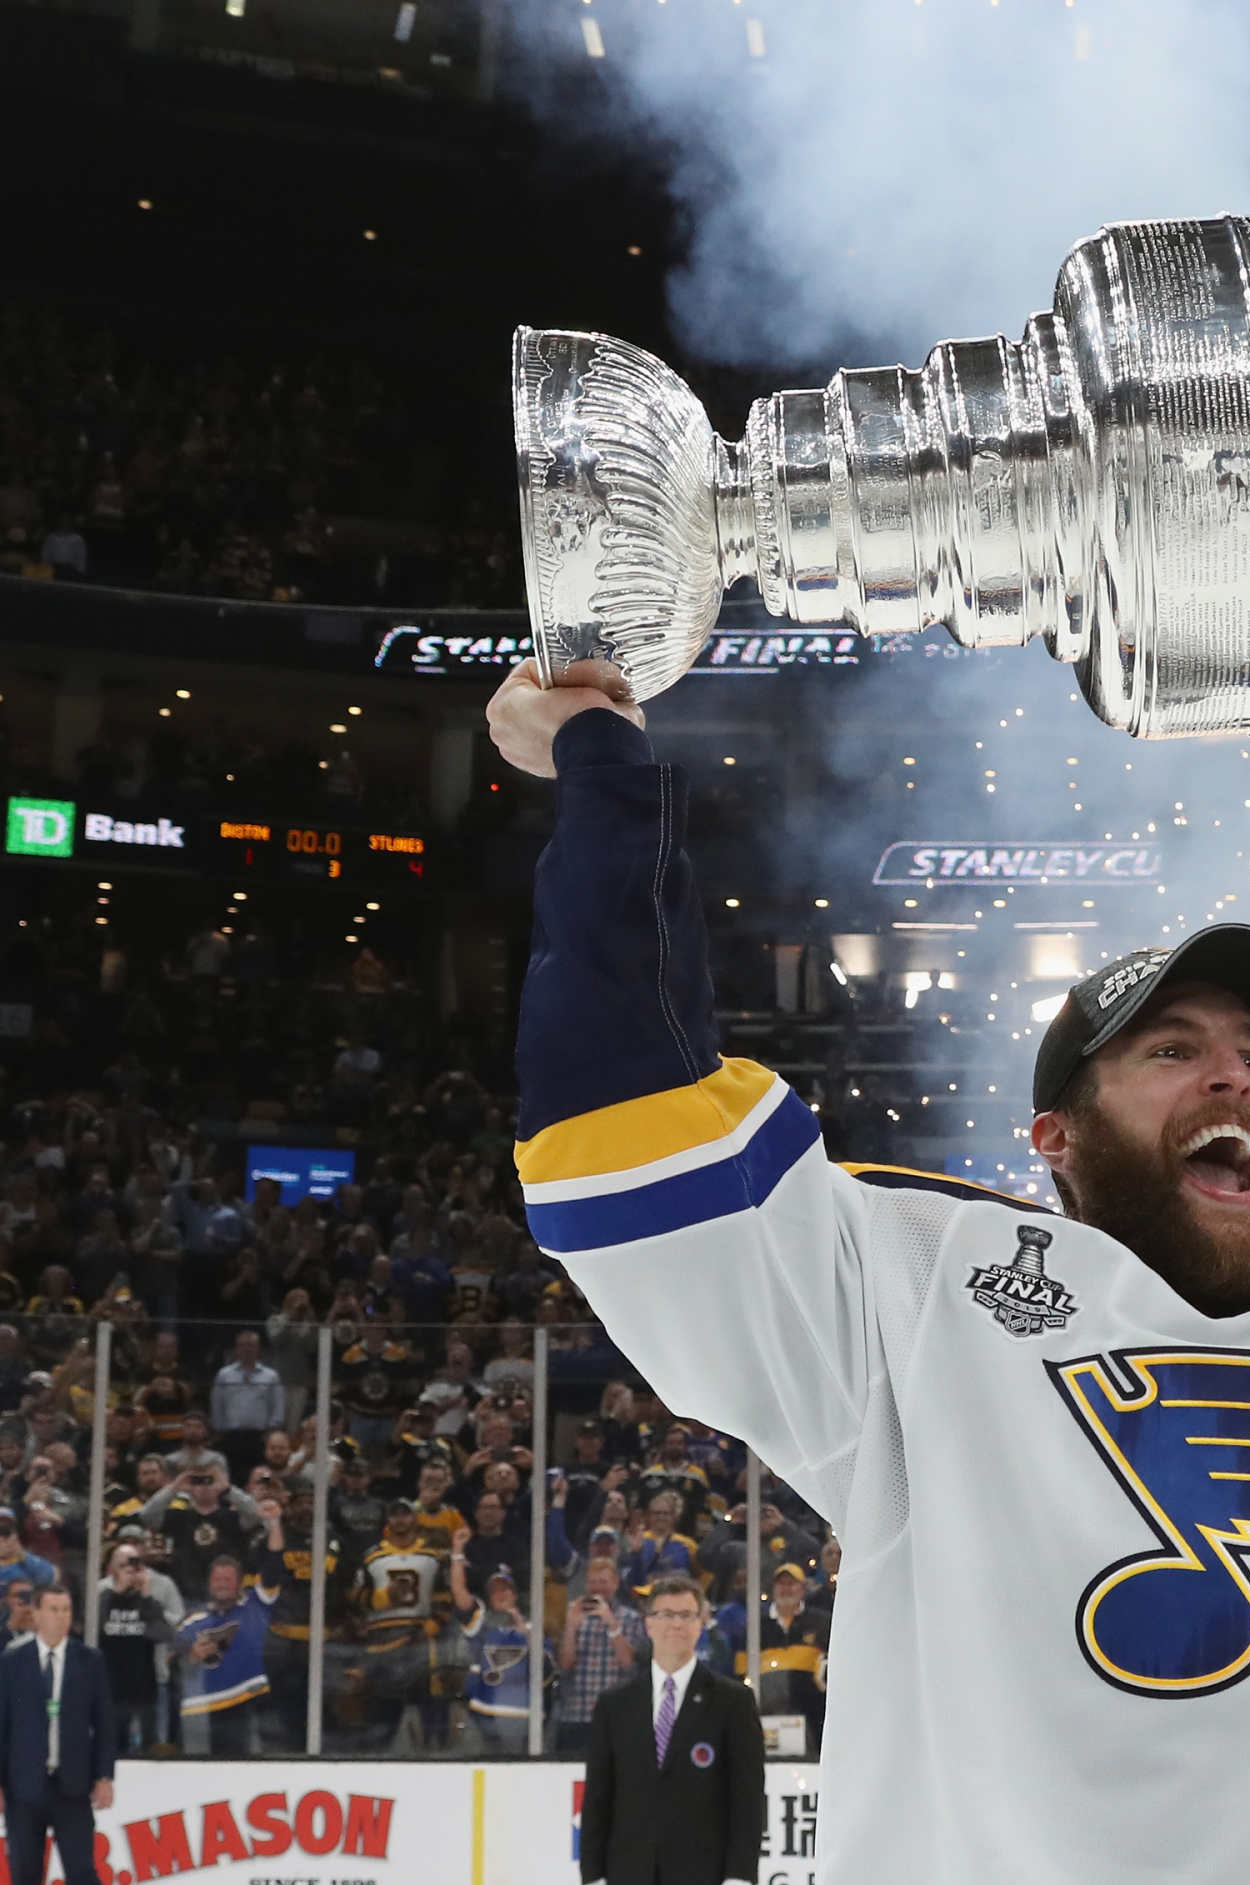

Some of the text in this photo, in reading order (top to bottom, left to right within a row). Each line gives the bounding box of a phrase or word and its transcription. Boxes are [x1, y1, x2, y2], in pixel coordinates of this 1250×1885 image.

[15, 807, 186, 849] TD Bank
[908, 849, 1103, 877] STANLEY
[974, 1272, 1075, 1314] FINAL
[990, 1266, 1064, 1292] STANLEY CUP
[1003, 1297, 1041, 1312] 2019
